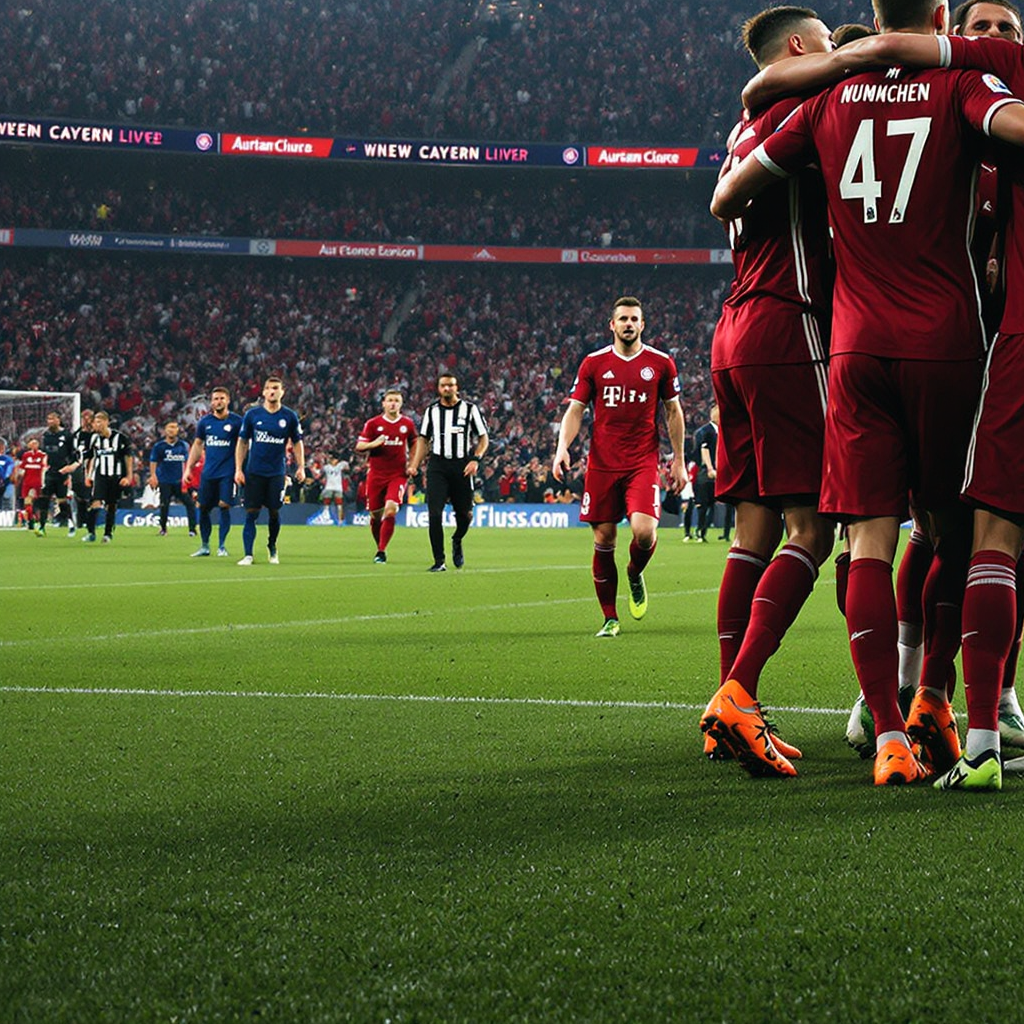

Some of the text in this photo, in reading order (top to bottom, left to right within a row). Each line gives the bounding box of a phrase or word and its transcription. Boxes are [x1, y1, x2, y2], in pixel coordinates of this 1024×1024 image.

[50, 125, 113, 143] CAYERN
[419, 146, 480, 161] CAYERN
[839, 117, 932, 224] 47
